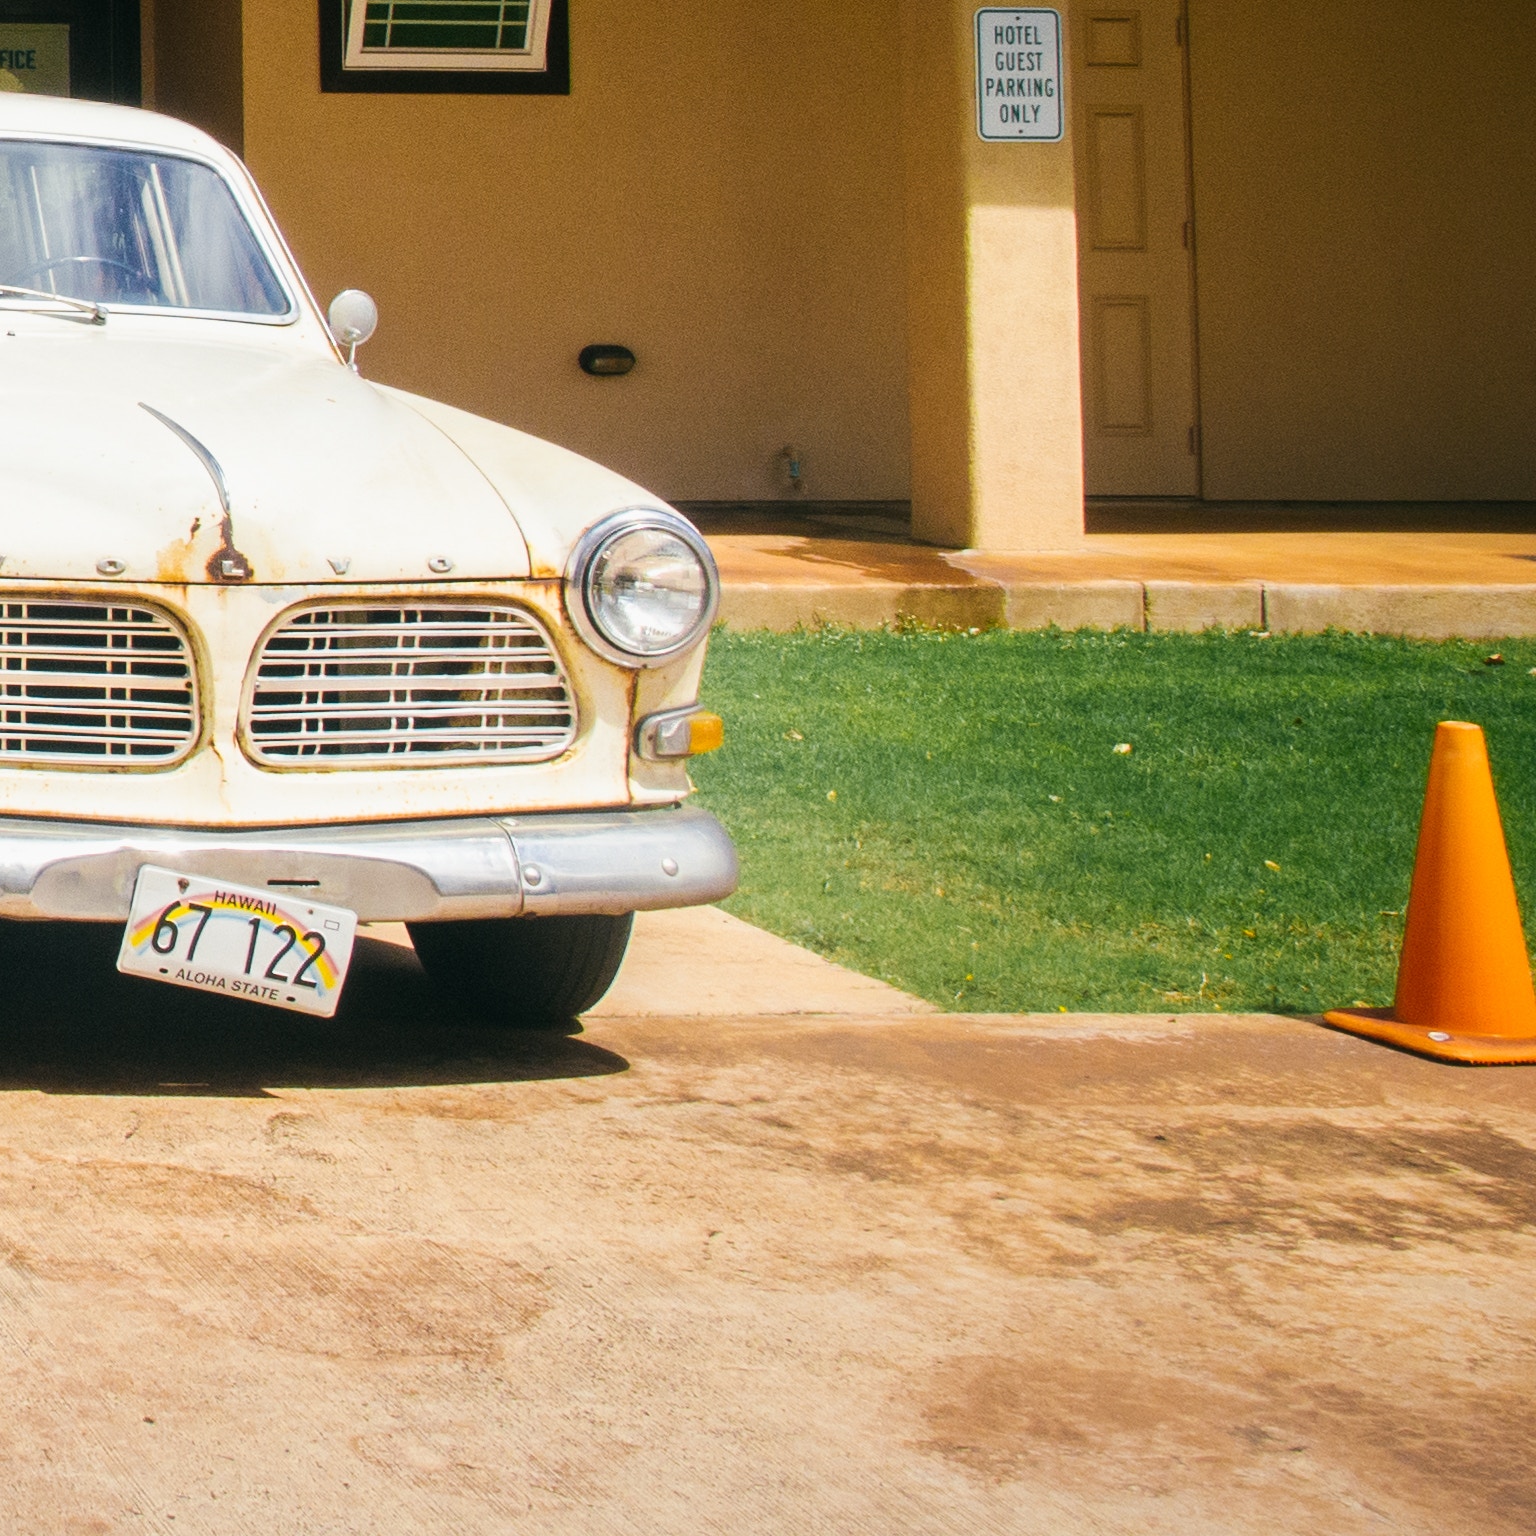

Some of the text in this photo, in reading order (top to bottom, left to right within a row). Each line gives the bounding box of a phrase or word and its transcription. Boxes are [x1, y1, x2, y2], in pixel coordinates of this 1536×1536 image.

[994, 25, 1043, 45] HOTEL
[995, 51, 1044, 71] GUEST
[985, 77, 1055, 98] PARKING
[999, 103, 1041, 124] ONLY
[214, 889, 278, 916] HAWAII
[151, 900, 326, 990] 67 122
[175, 967, 280, 1002] ALOHA STATE
